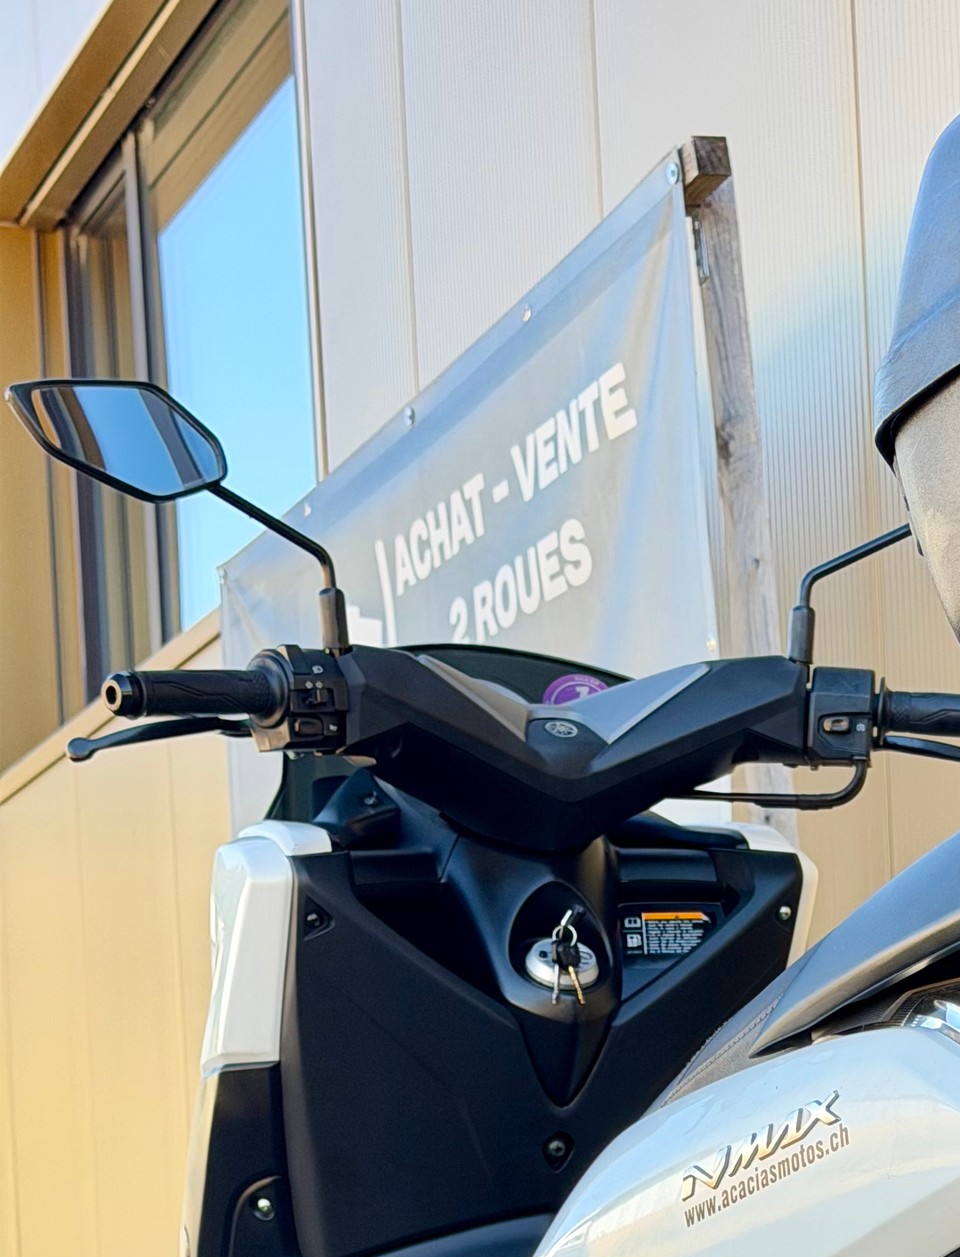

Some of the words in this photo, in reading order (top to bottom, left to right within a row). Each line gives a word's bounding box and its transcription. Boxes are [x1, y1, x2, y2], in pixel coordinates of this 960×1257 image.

[394, 473, 485, 596] ACHAT
[511, 362, 637, 502] VENTE
[449, 597, 470, 644] 2
[472, 518, 593, 643] ROUES
[684, 1123, 851, 1228] www.acaciasmotos.ch
